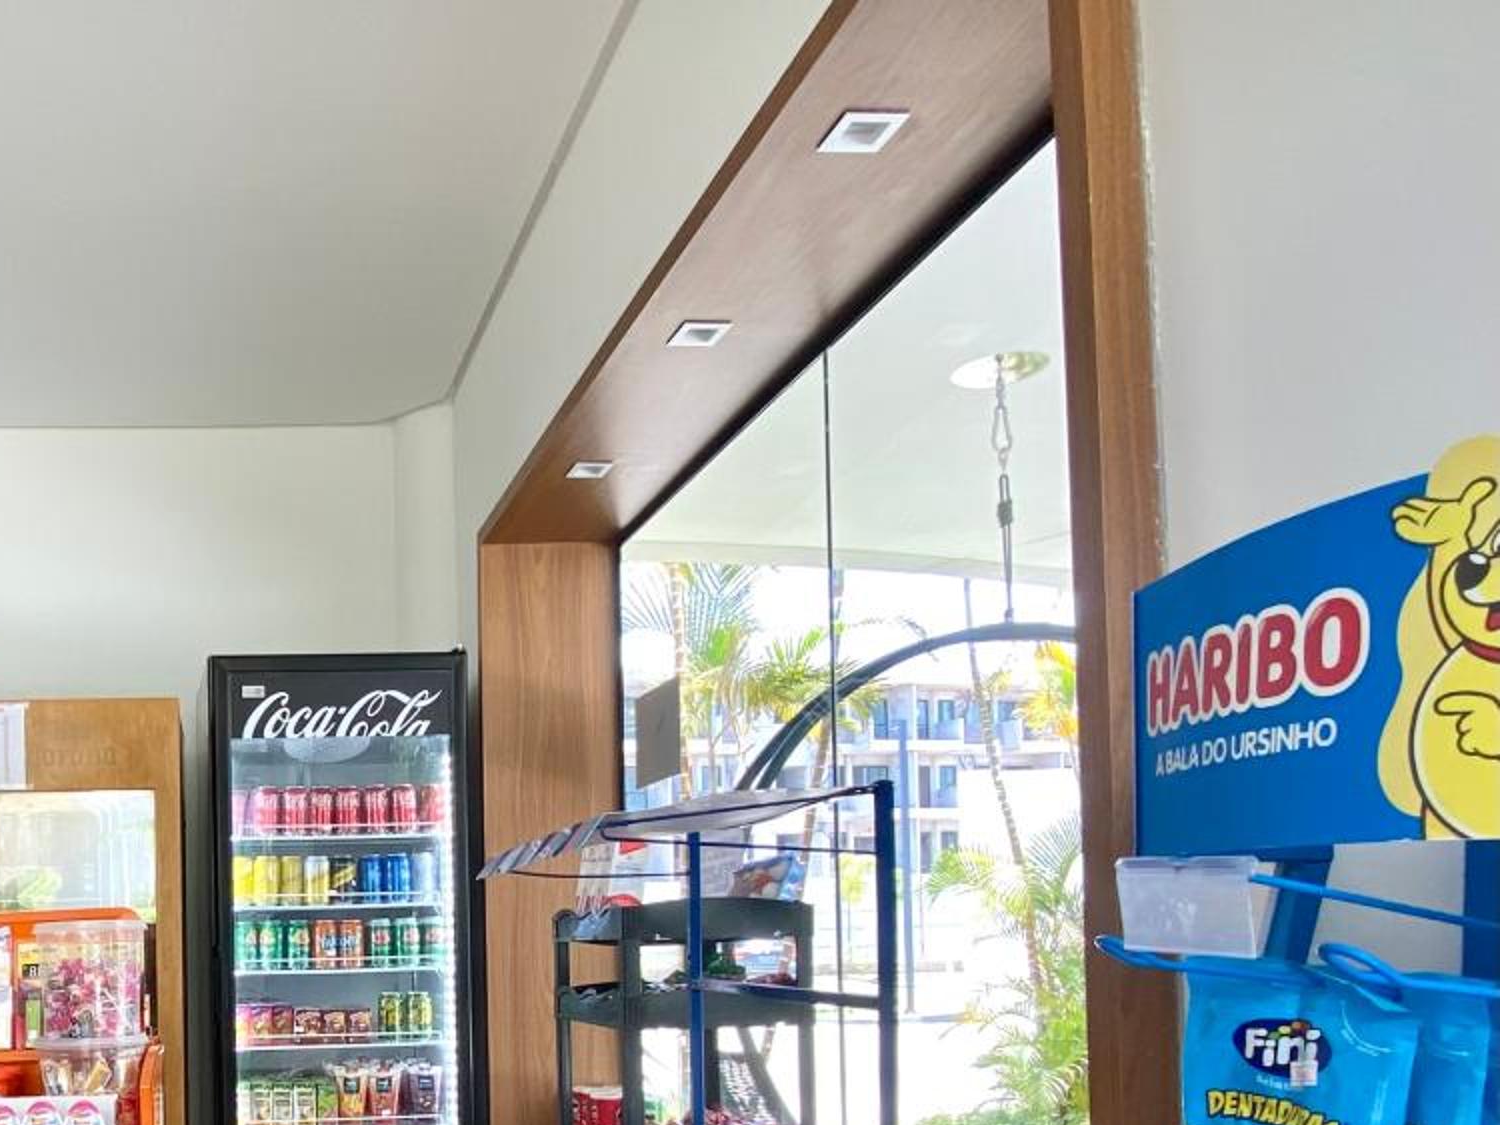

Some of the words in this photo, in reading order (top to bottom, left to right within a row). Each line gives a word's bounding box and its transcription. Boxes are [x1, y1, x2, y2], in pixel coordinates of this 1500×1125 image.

[1147, 588, 1370, 736] HARIBO
[242, 689, 443, 739] Coca-Cola
[1155, 752, 1166, 777] A
[1166, 744, 1199, 774] BALA
[1202, 737, 1228, 766] DO
[1231, 717, 1338, 760] URSINHO
[1245, 1027, 1321, 1068] Fini
